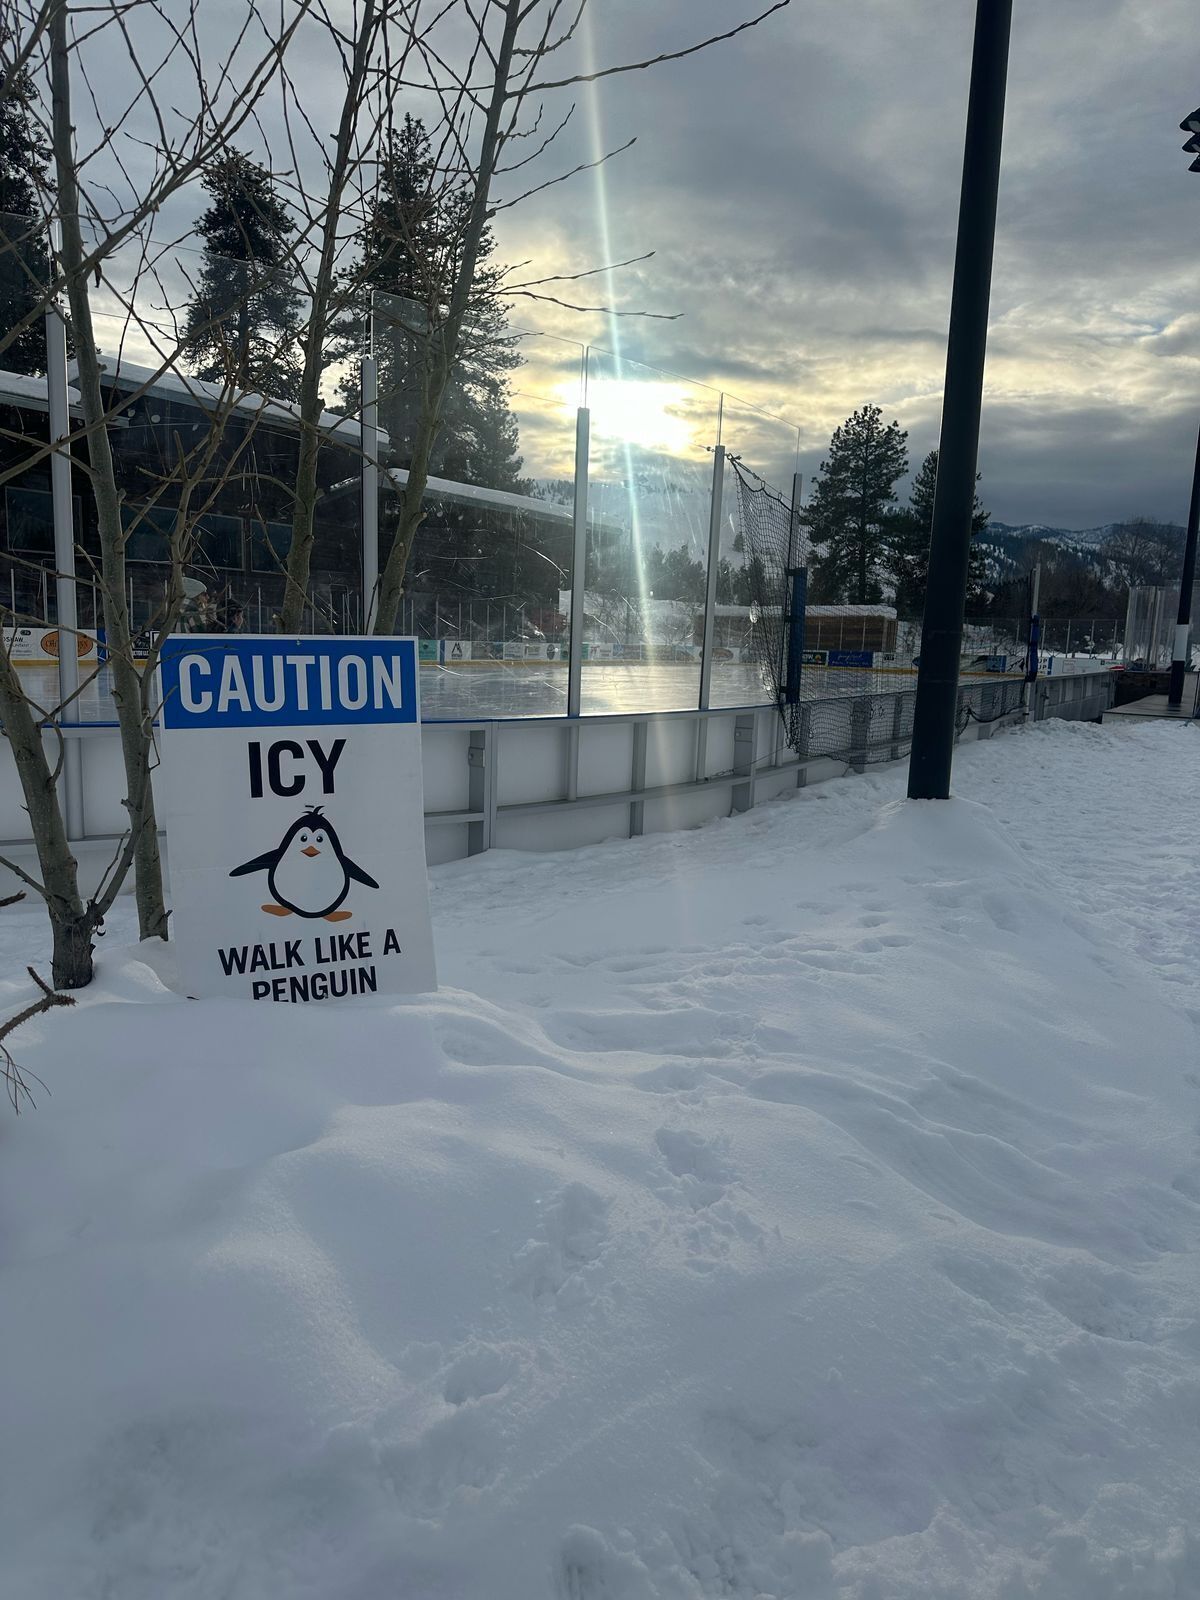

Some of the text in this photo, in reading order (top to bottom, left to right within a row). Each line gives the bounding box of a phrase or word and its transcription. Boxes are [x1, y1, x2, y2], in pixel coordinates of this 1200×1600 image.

[178, 654, 402, 714] CAUTION
[248, 739, 347, 798] ICY
[218, 928, 401, 976] WALK LIKE A
[252, 965, 377, 1003] PENGUIN
